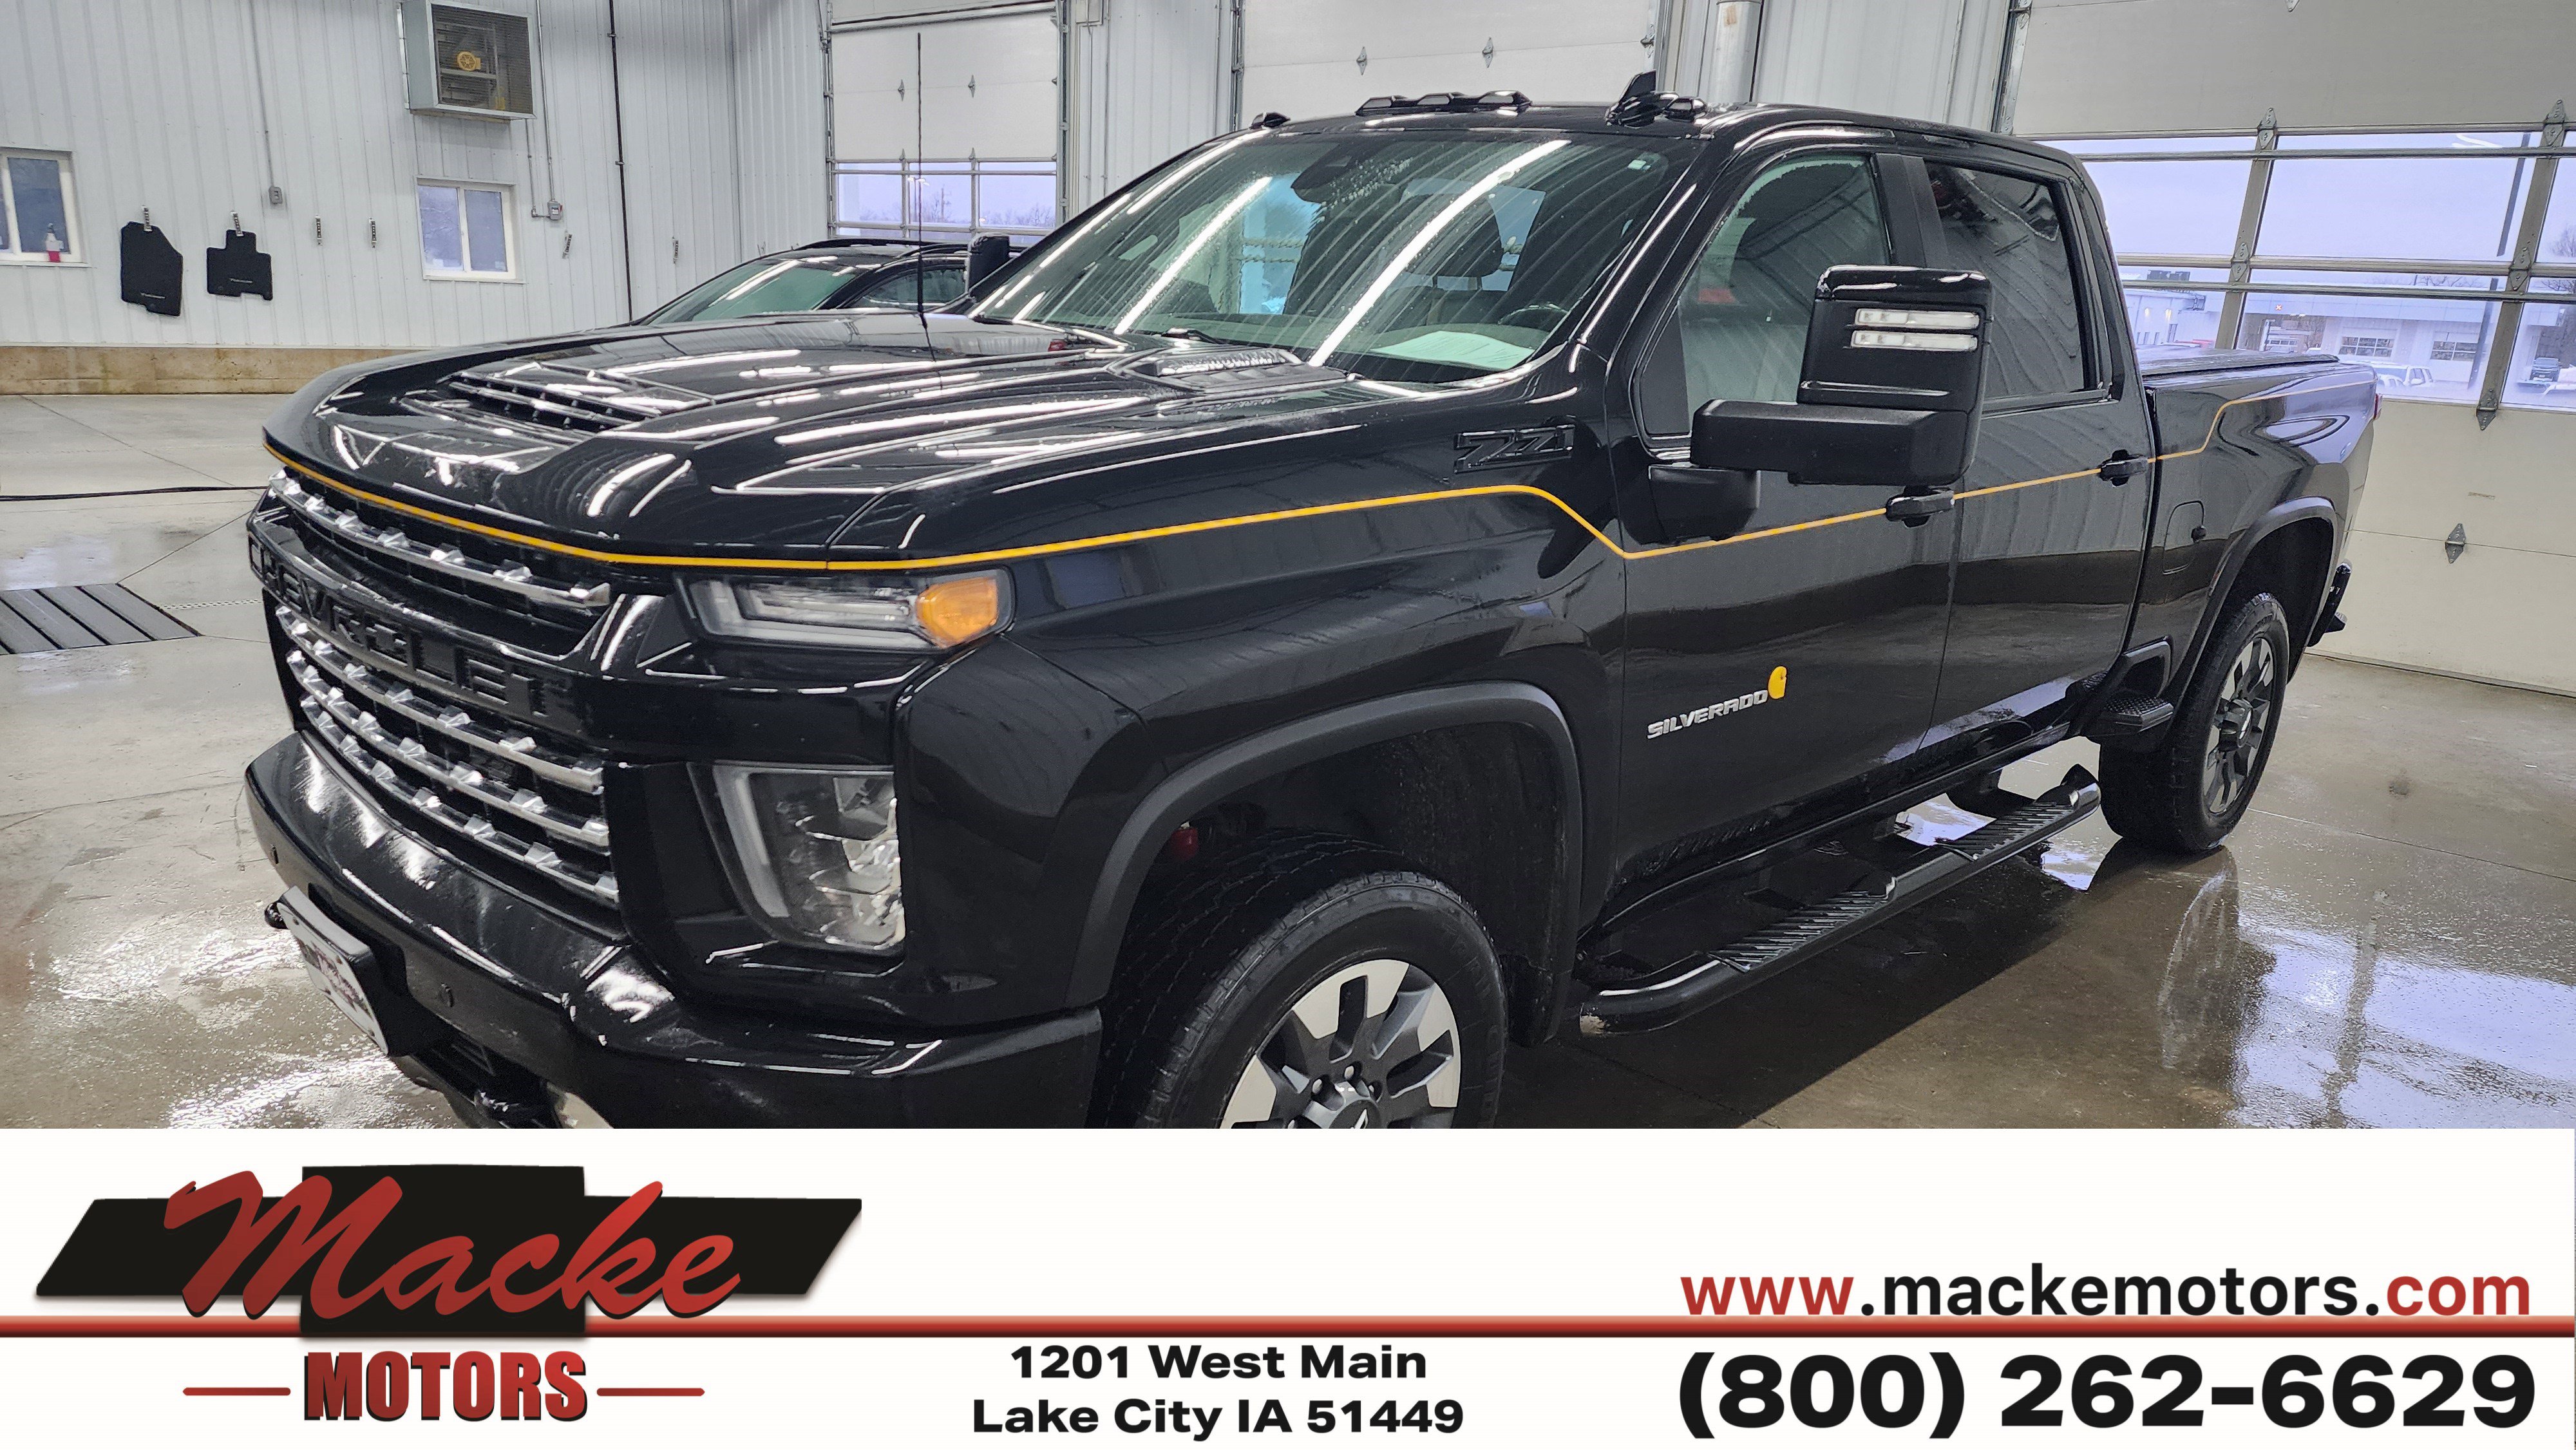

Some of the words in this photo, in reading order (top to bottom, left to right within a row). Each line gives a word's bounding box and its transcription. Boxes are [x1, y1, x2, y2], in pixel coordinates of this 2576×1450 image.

[1454, 424, 1576, 473] Z71
[249, 534, 571, 719] CHEVROLET
[1647, 690, 1768, 739] SILVERADO
